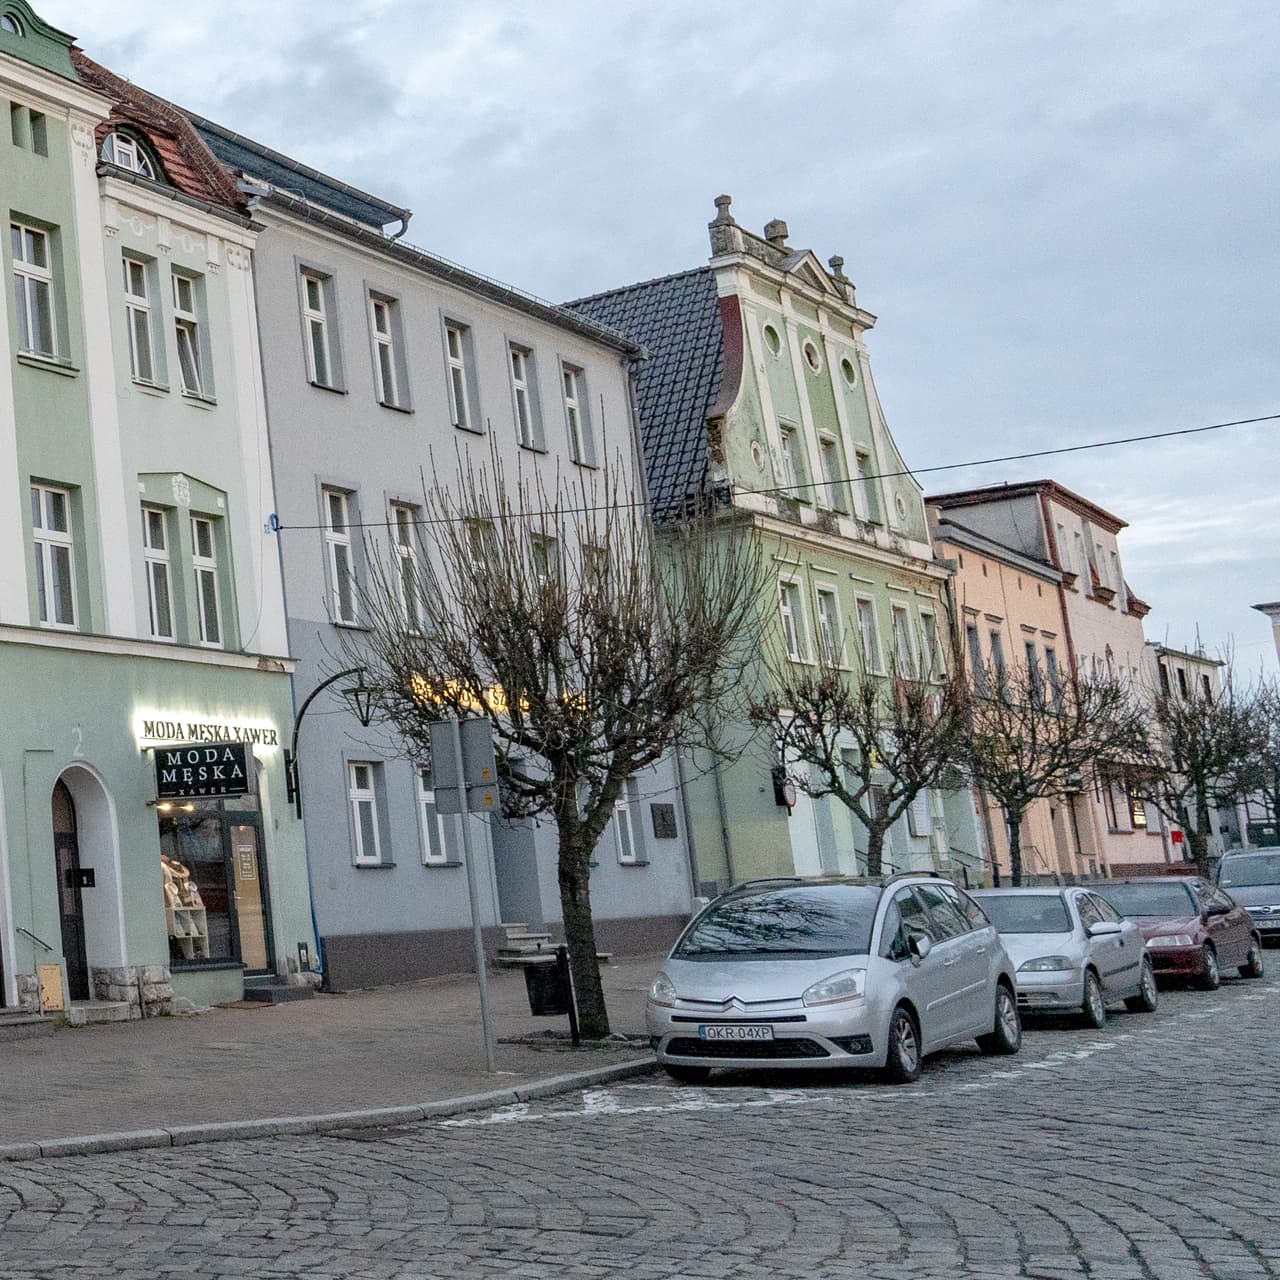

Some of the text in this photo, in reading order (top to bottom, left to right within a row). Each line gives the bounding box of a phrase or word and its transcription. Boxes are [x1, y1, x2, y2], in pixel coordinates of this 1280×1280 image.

[71, 727, 85, 757] 2
[143, 720, 185, 740] MODA
[233, 726, 279, 746] XAWER
[167, 747, 235, 766] MODA
[162, 764, 244, 785] MĘSKA
[180, 787, 227, 796] XAWER
[707, 1027, 770, 1039] OKR 04XP
